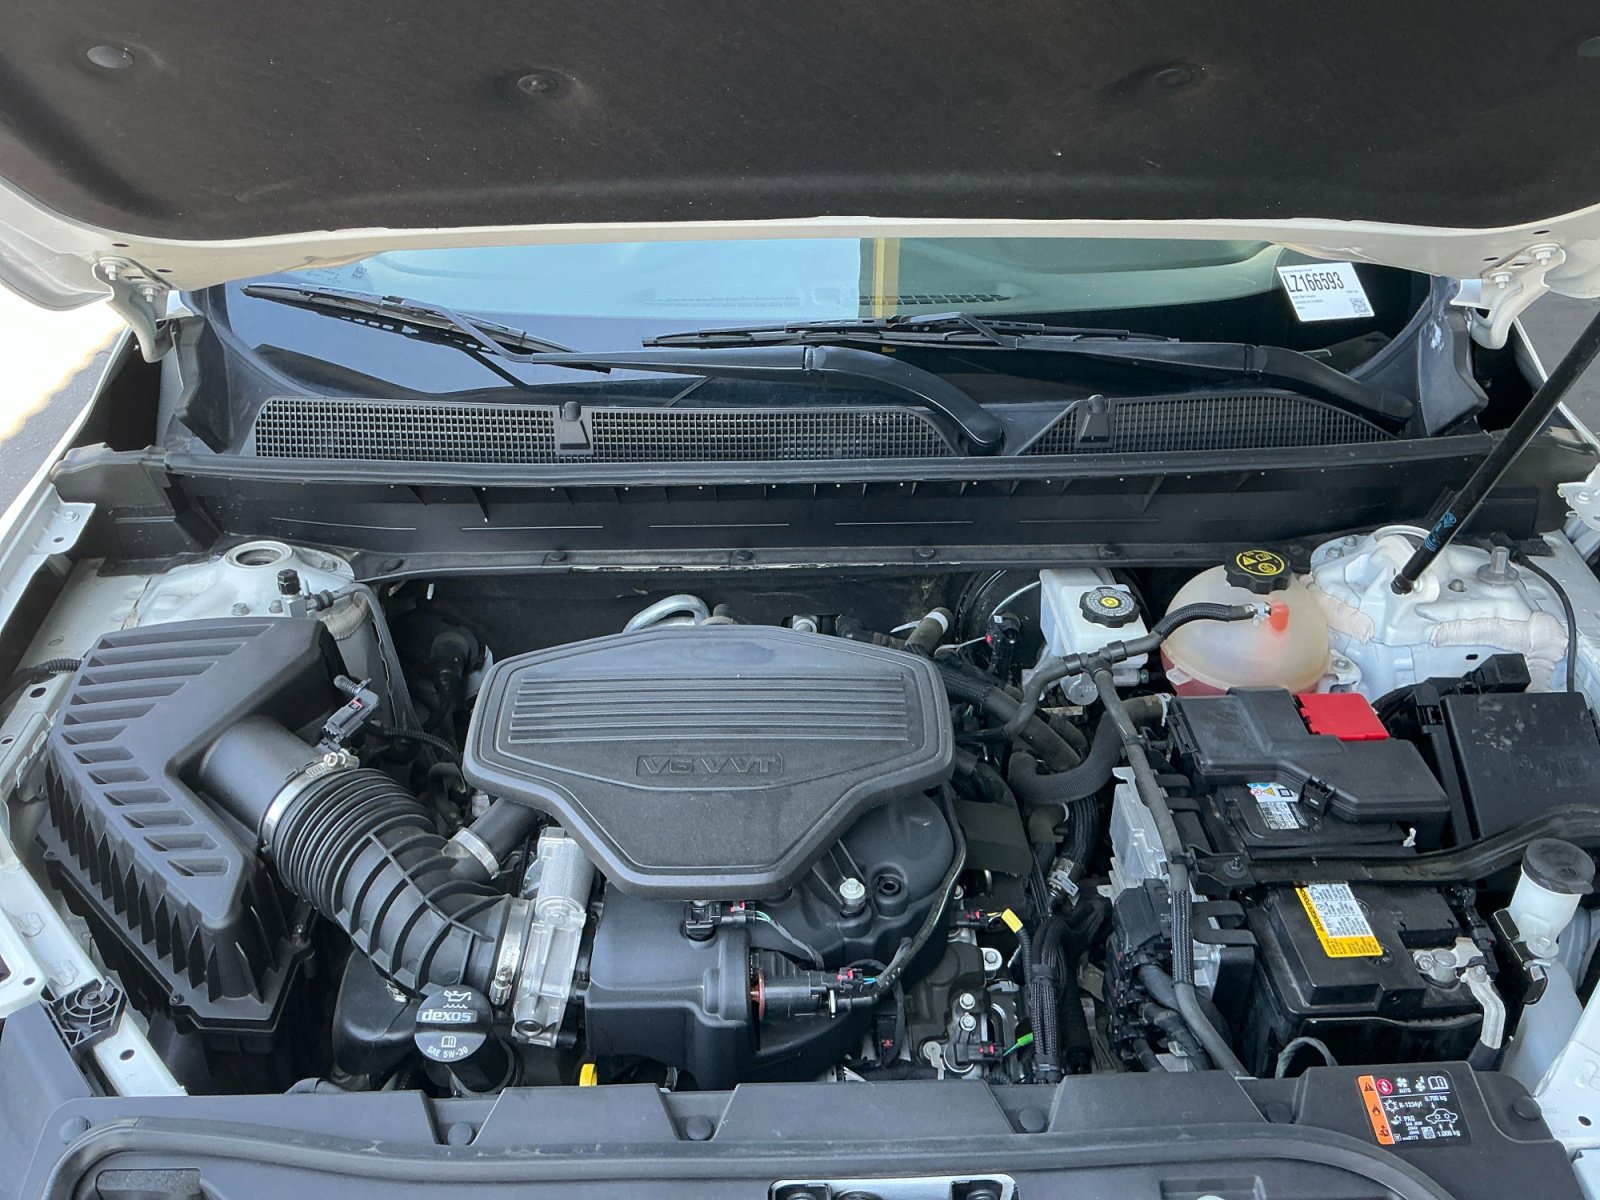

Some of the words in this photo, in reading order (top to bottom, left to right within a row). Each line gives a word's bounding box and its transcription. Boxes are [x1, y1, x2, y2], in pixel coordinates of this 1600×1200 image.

[1283, 271, 1345, 293] LZ166593
[642, 756, 694, 774] V6
[701, 756, 776, 773] VVT
[421, 1009, 473, 1022] dexos
[427, 1045, 441, 1057] SAE
[443, 1046, 469, 1058] 5W-30
